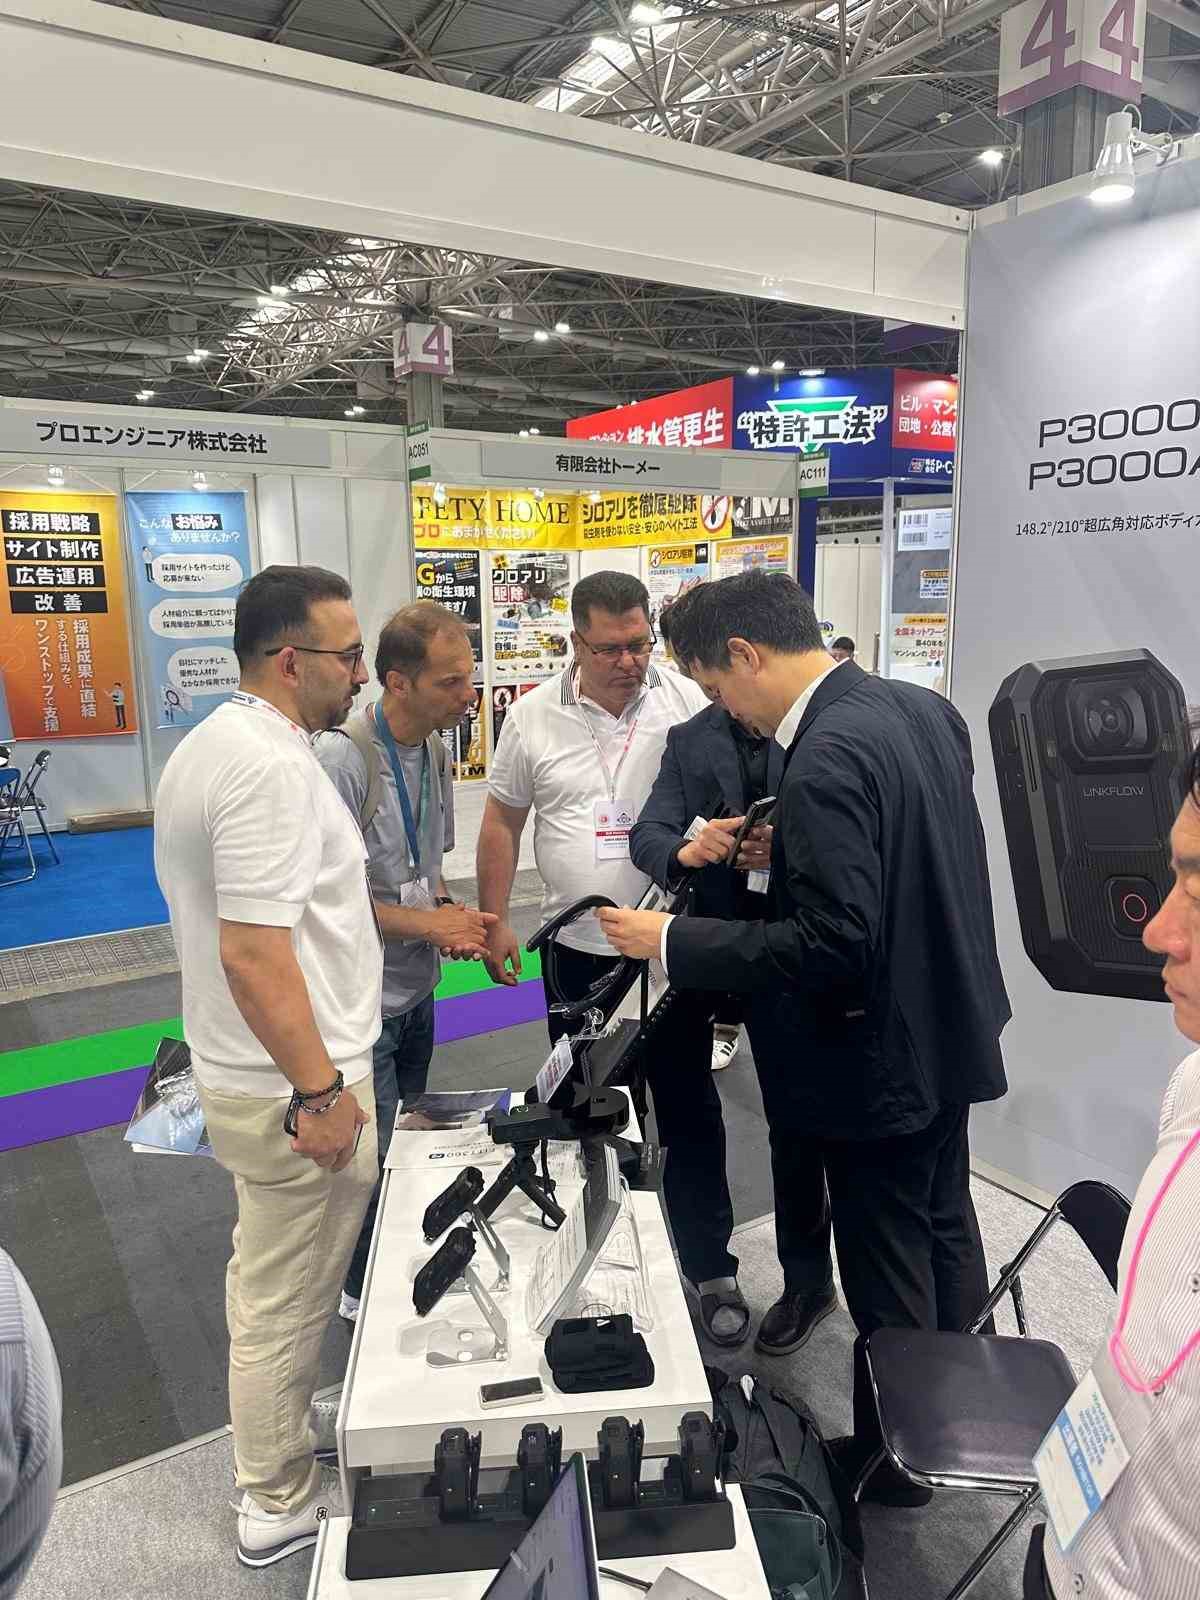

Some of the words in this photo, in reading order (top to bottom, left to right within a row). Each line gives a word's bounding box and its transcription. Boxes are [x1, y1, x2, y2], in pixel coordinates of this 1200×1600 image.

[422, 325, 450, 370] 4
[626, 407, 725, 448] 排水管更生
[1038, 398, 1200, 449] P3000
[36, 421, 268, 454] プロエンジニア株式会社
[408, 442, 429, 460] AC051
[555, 454, 661, 474] 有限会社トーメー
[800, 466, 826, 480] AC111
[414, 496, 485, 521] FETY
[496, 499, 569, 524] HOME
[9, 512, 91, 532] 採用戦略
[6, 540, 99, 559] サイト制作
[16, 566, 95, 585] 広告運用
[493, 569, 545, 584] クロアリ
[35, 619, 60, 732] ワンストップで支援
[73, 619, 97, 719] 採用成果に直結
[1082, 786, 1144, 797] LINKFLOW
